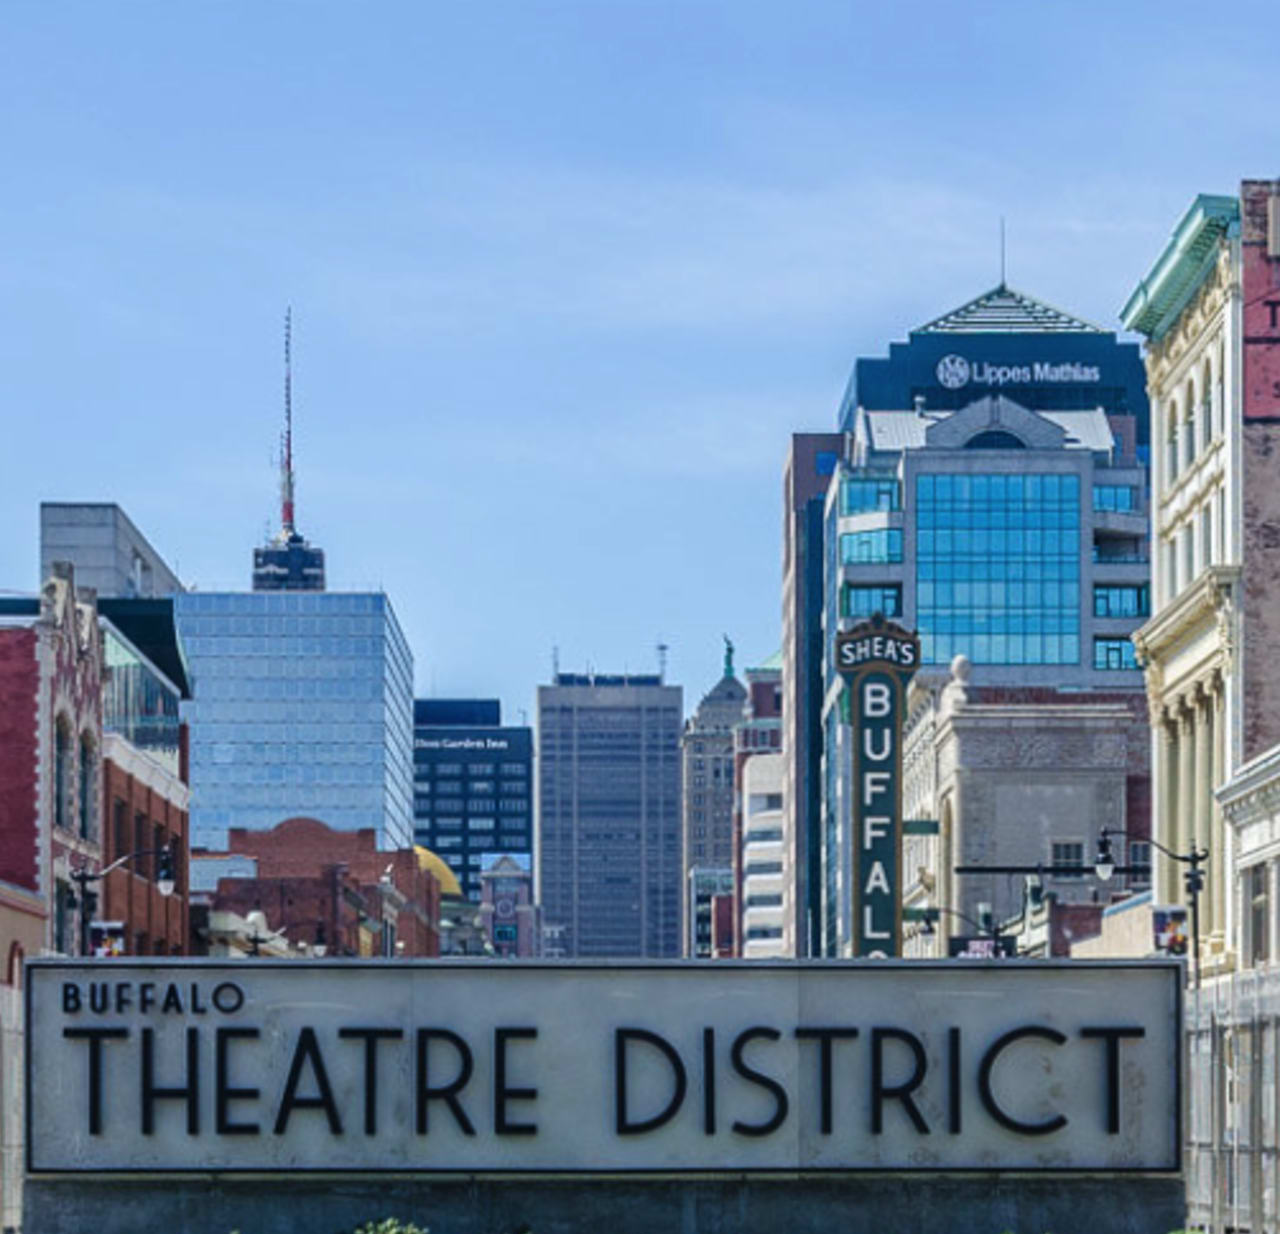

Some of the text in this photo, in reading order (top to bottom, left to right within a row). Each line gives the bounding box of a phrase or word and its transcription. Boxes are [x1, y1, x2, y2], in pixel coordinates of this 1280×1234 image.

[972, 361, 1101, 385] Lippes Mathias
[841, 636, 915, 665] SHEA'S
[863, 682, 892, 958] BUFFAL
[62, 982, 246, 1015] BUFFALO
[63, 1025, 1146, 1137] THEATRE DISTRICT
